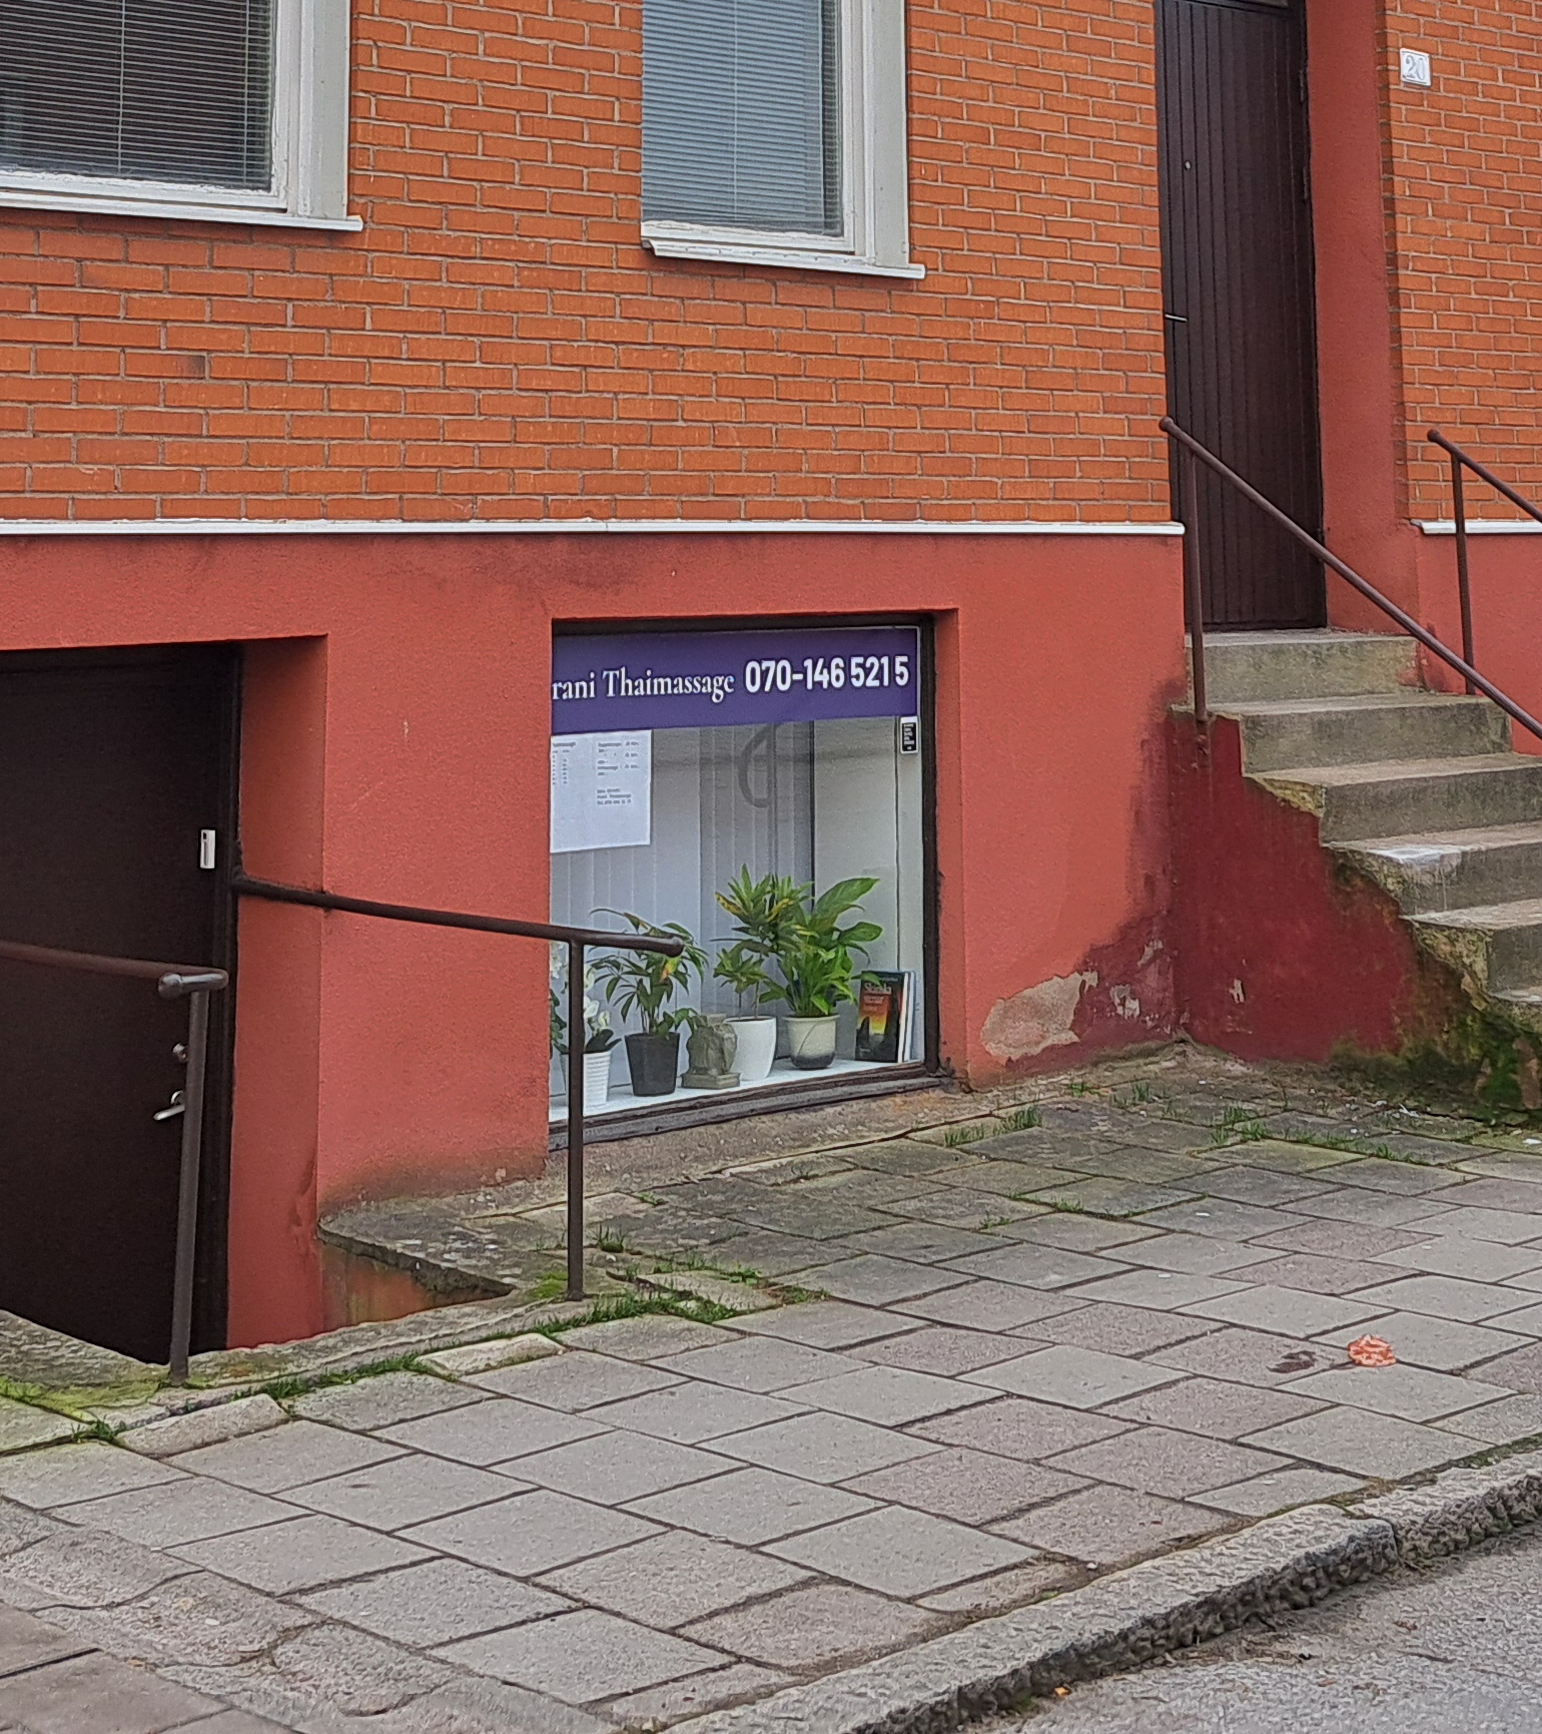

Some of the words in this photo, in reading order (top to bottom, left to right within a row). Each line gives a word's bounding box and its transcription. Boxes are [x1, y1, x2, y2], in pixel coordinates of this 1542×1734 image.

[1405, 54, 1426, 81] 20
[602, 665, 735, 703] Thaimassage
[745, 657, 846, 693] 070-146
